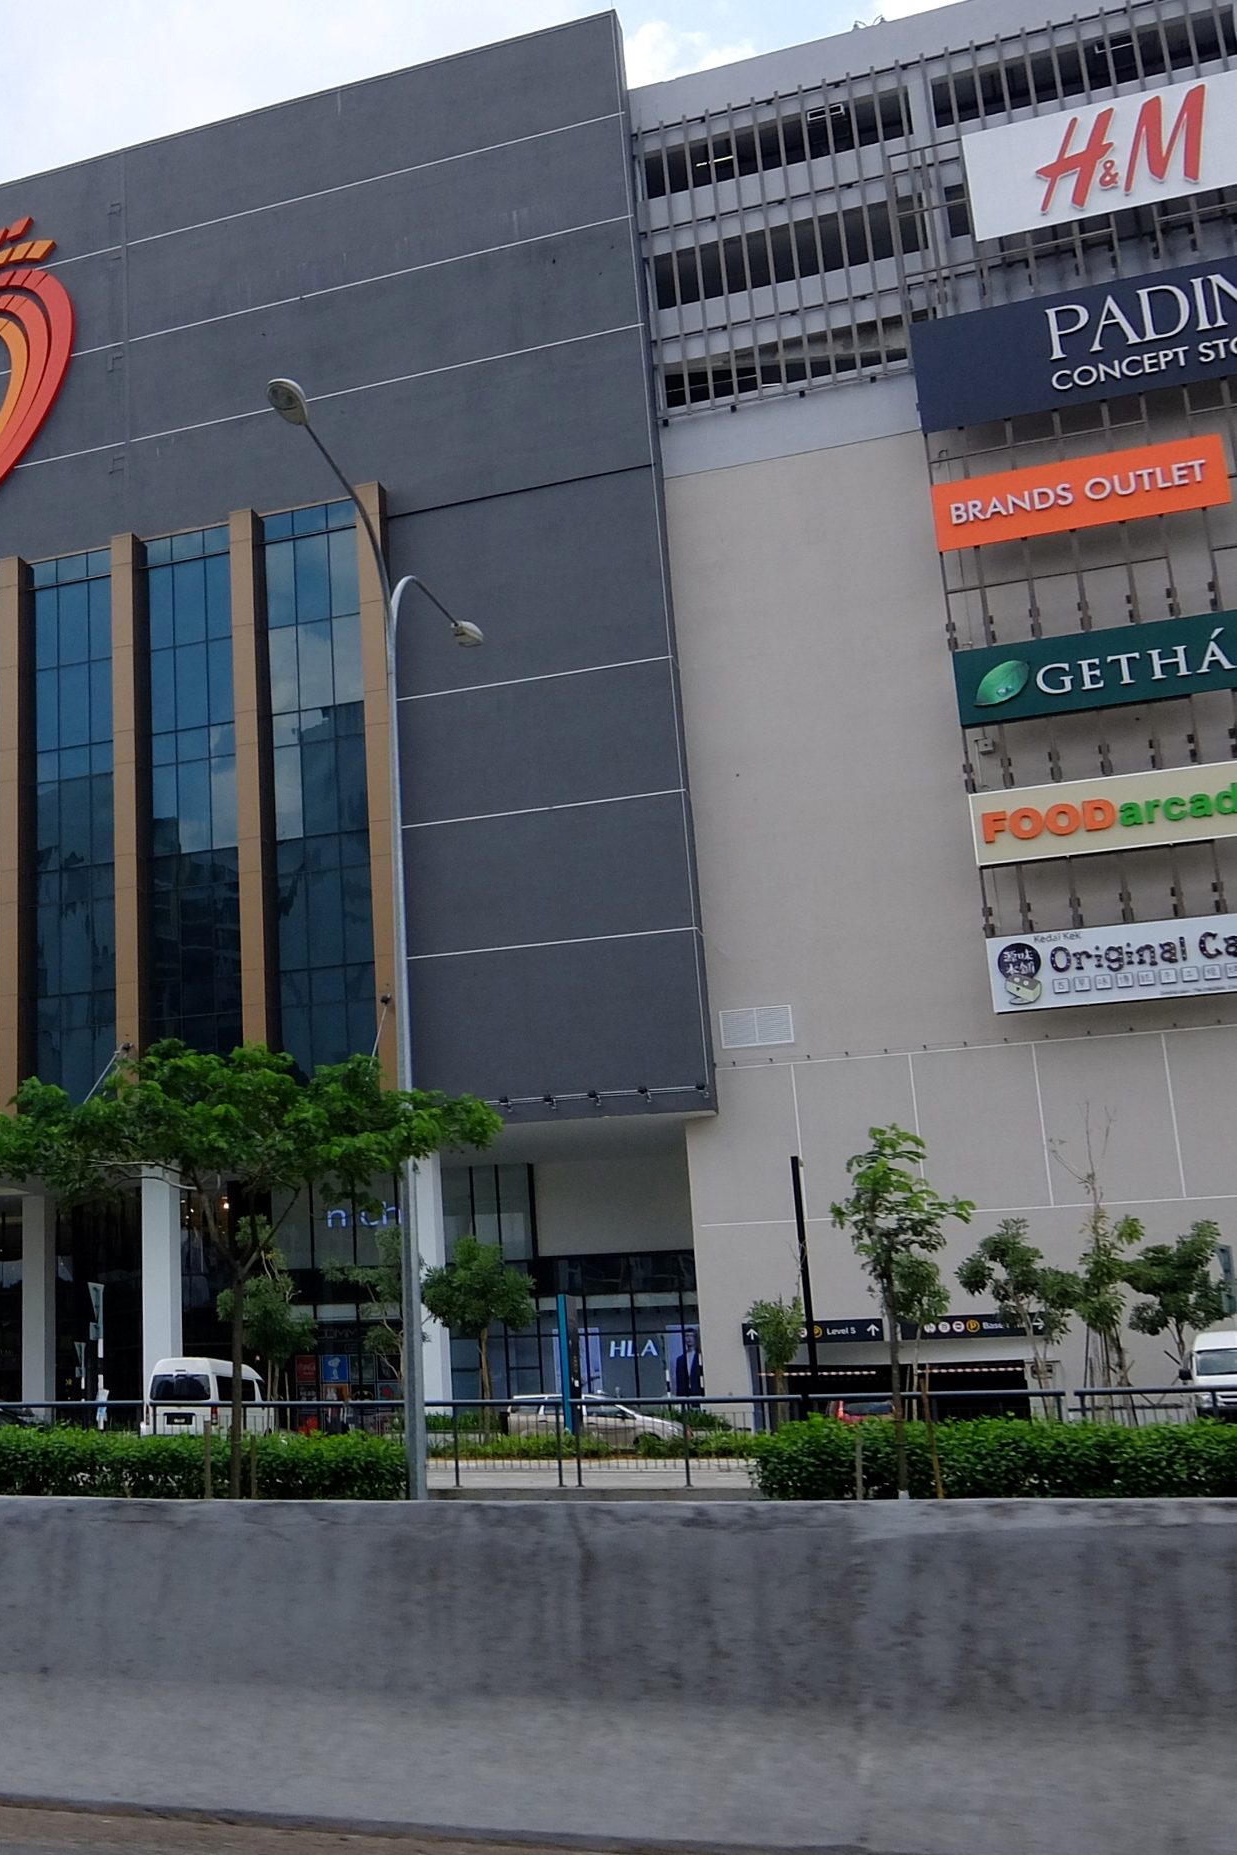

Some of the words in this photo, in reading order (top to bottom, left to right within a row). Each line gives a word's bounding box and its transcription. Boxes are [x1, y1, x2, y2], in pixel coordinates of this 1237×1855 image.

[1035, 83, 1206, 215] H&M
[1051, 346, 1190, 392] CONCEPT
[949, 483, 1075, 527] BRANDS
[1084, 458, 1207, 501] OUTLET
[1049, 936, 1188, 973] Original
[609, 1339, 659, 1358] HLA
[826, 1326, 849, 1336] Level
[850, 1326, 857, 1335] 5
